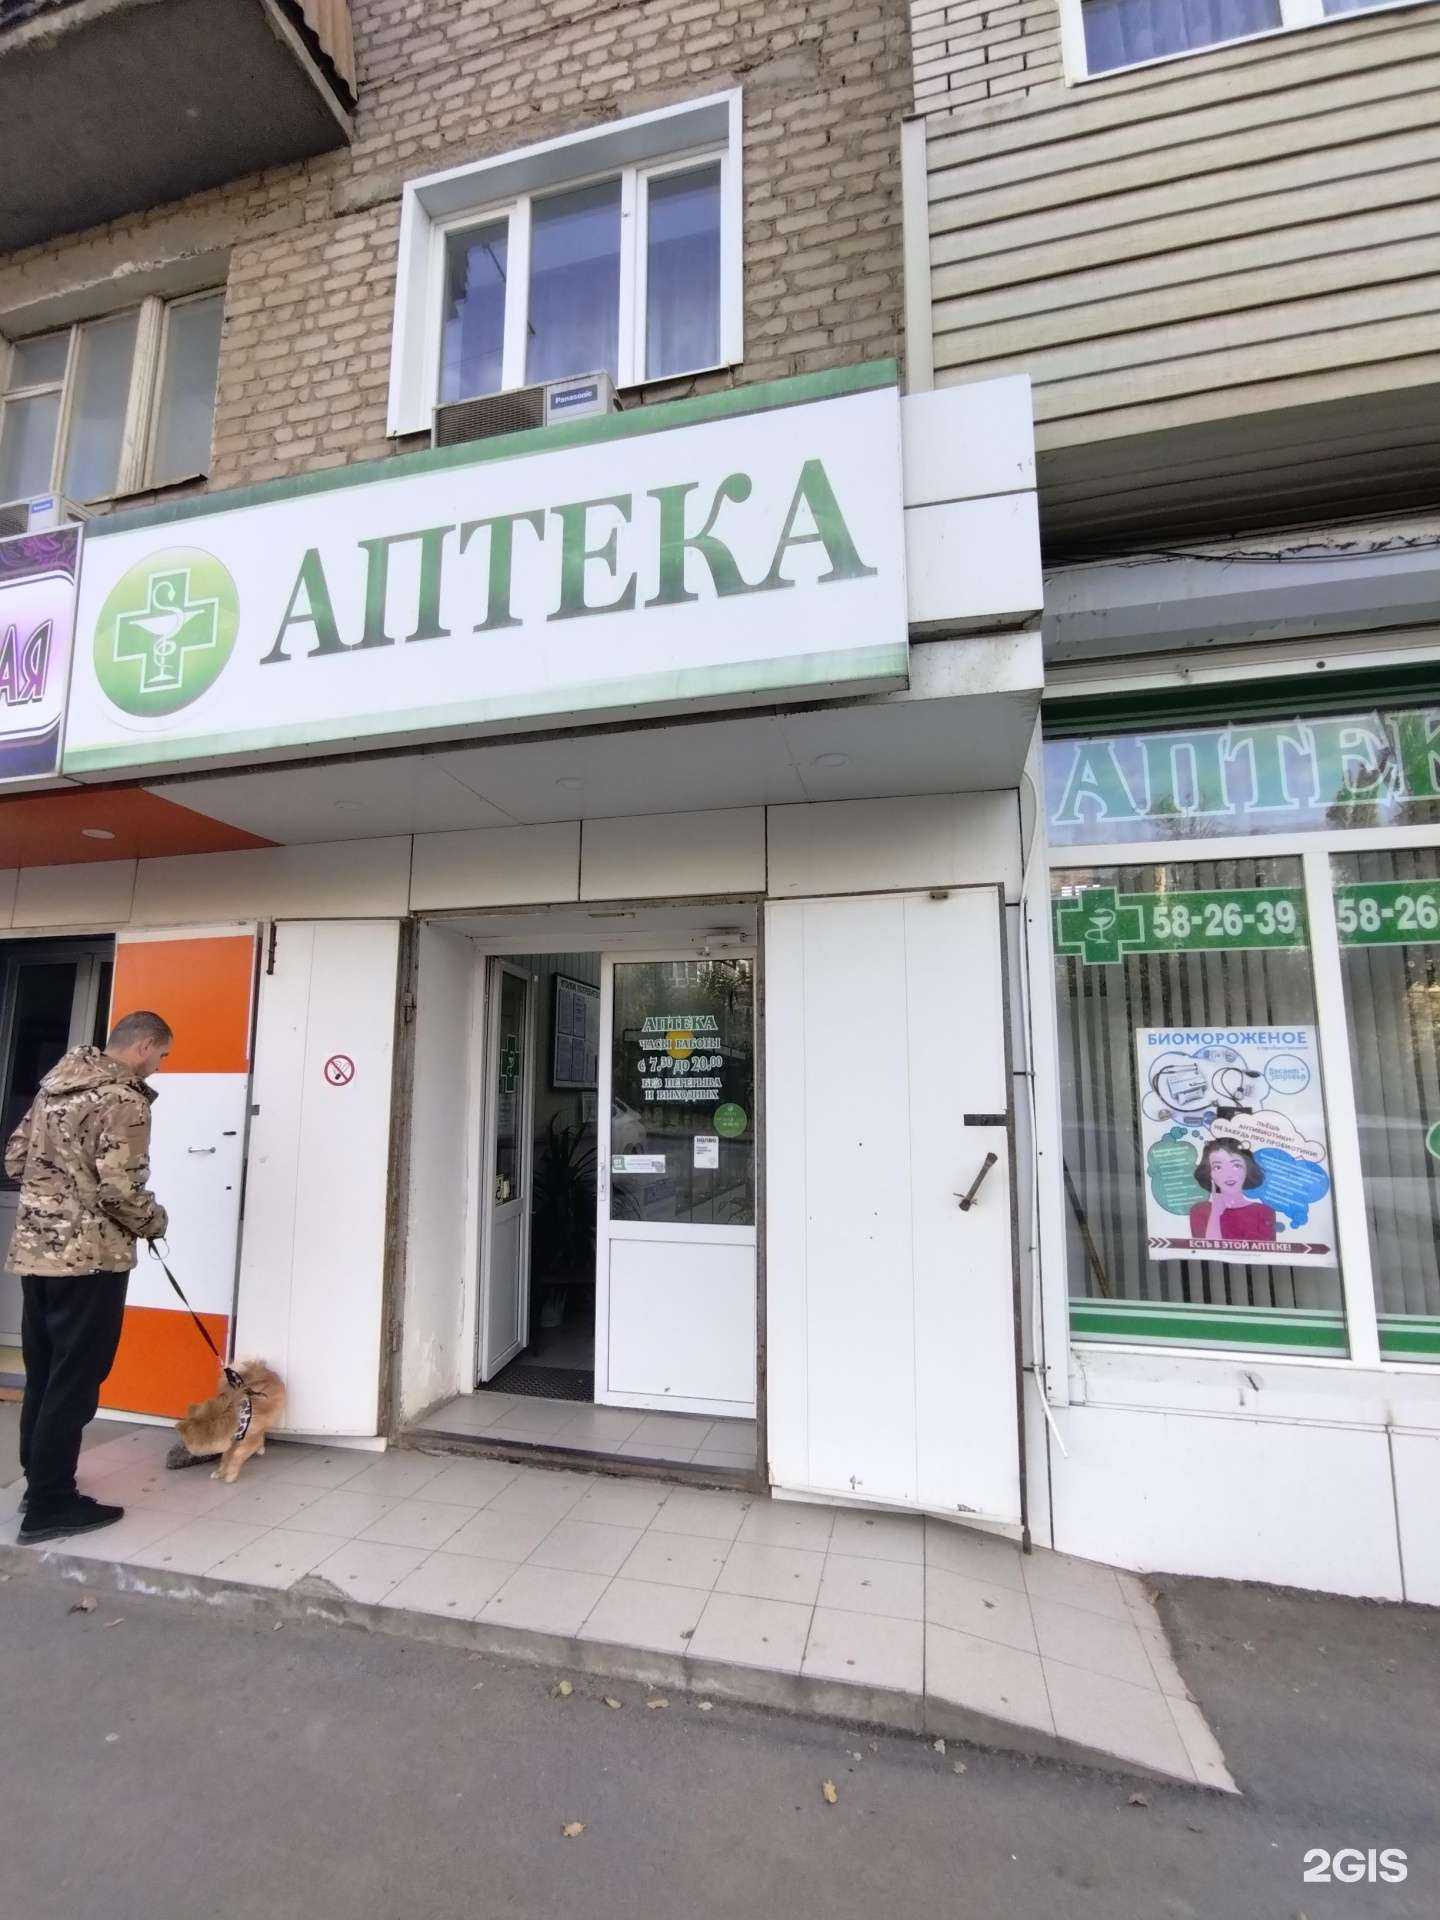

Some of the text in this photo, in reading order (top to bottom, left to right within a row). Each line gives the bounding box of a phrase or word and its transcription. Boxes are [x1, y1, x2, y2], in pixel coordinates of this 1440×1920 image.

[555, 390, 593, 404] Panasonic
[259, 458, 878, 665] АПТЕКА
[1152, 900, 1297, 938] 58-26-39
[641, 1015, 719, 1032] АПТЕКА
[639, 1037, 721, 1051] ЧАСЫ РАБОТЫ
[1147, 1031, 1308, 1046] БИОМОРОЖЕНОЕ
[690, 1056, 723, 1072] 20.00
[641, 1077, 722, 1089] БЕЗ ПЕРЕРЫВА
[645, 1089, 719, 1102] И ВЫХОДНЫХ
[1189, 1239, 1291, 1252] ЕСТЬ В ЭТОЙ АПТЕКЕ!
